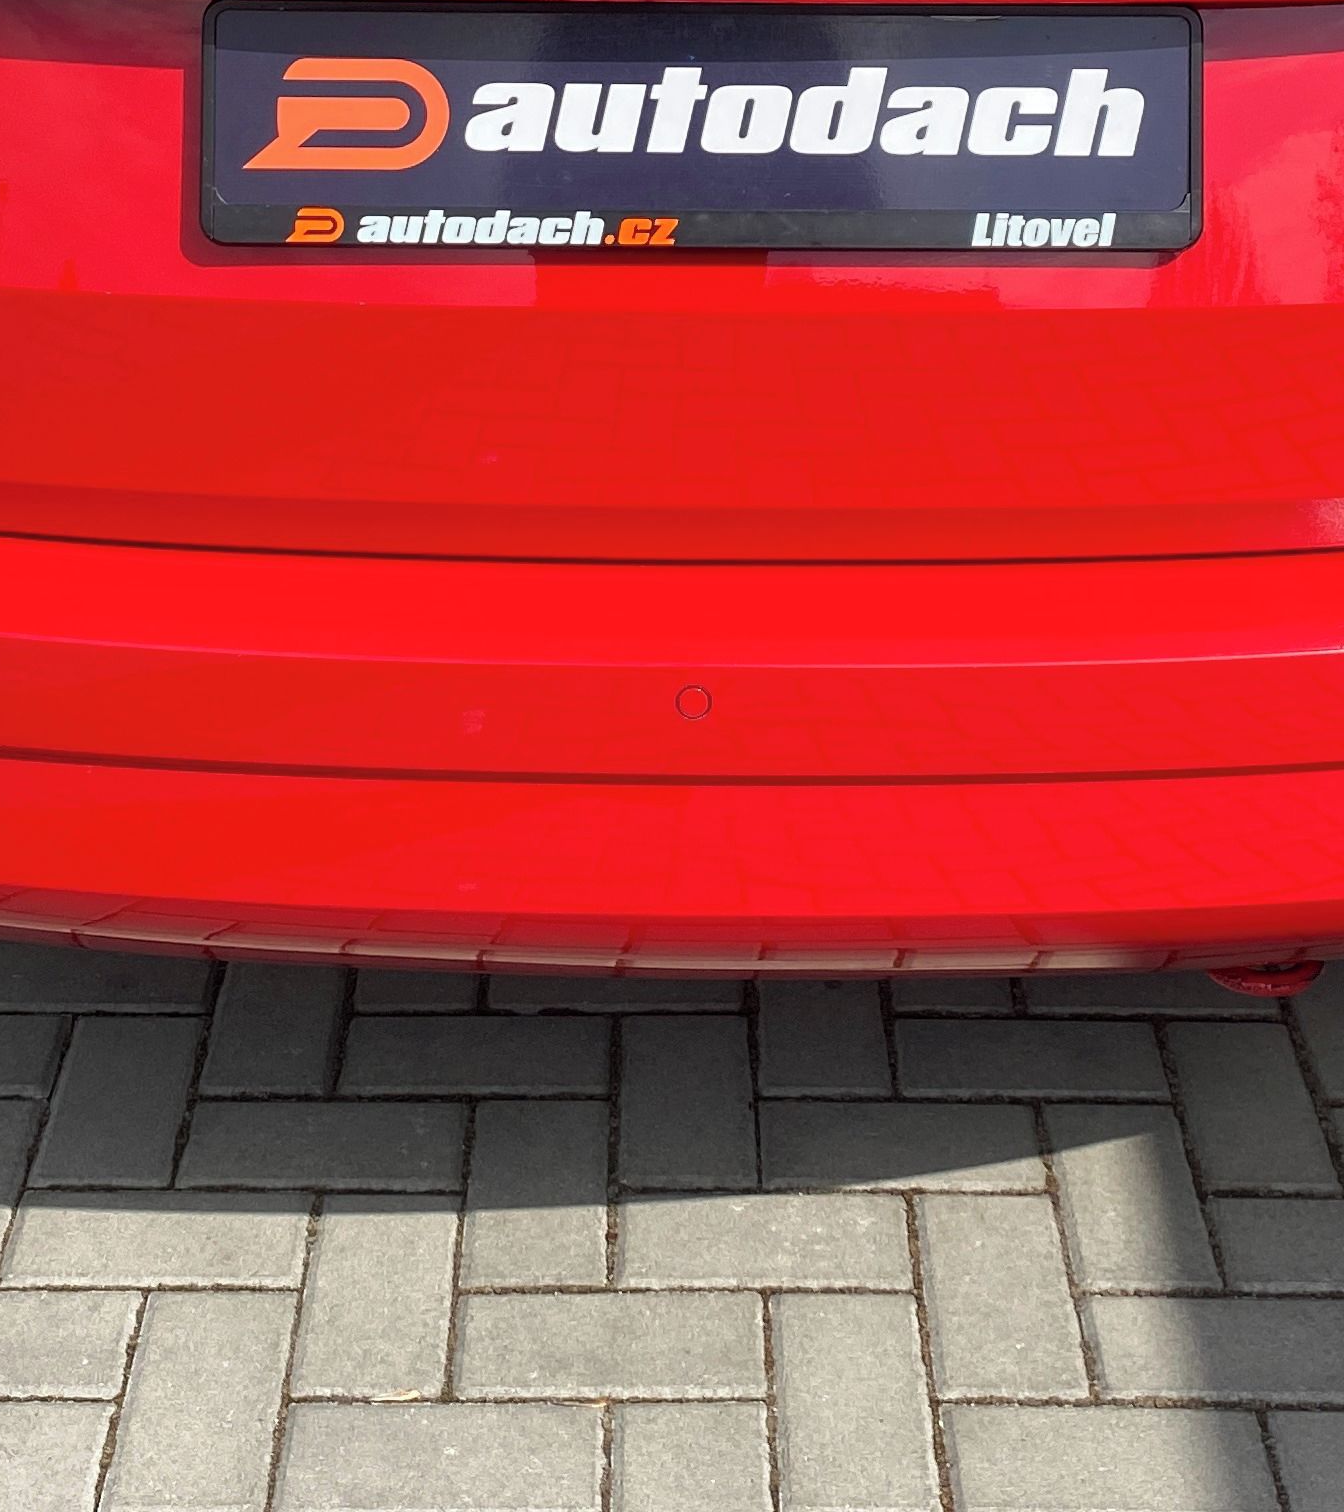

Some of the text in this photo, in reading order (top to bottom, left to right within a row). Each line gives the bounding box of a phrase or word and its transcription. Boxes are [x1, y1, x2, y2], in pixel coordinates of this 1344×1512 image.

[462, 65, 1145, 157] autodach
[356, 209, 680, 246] autodach.cz
[971, 212, 1117, 247] Litovel
